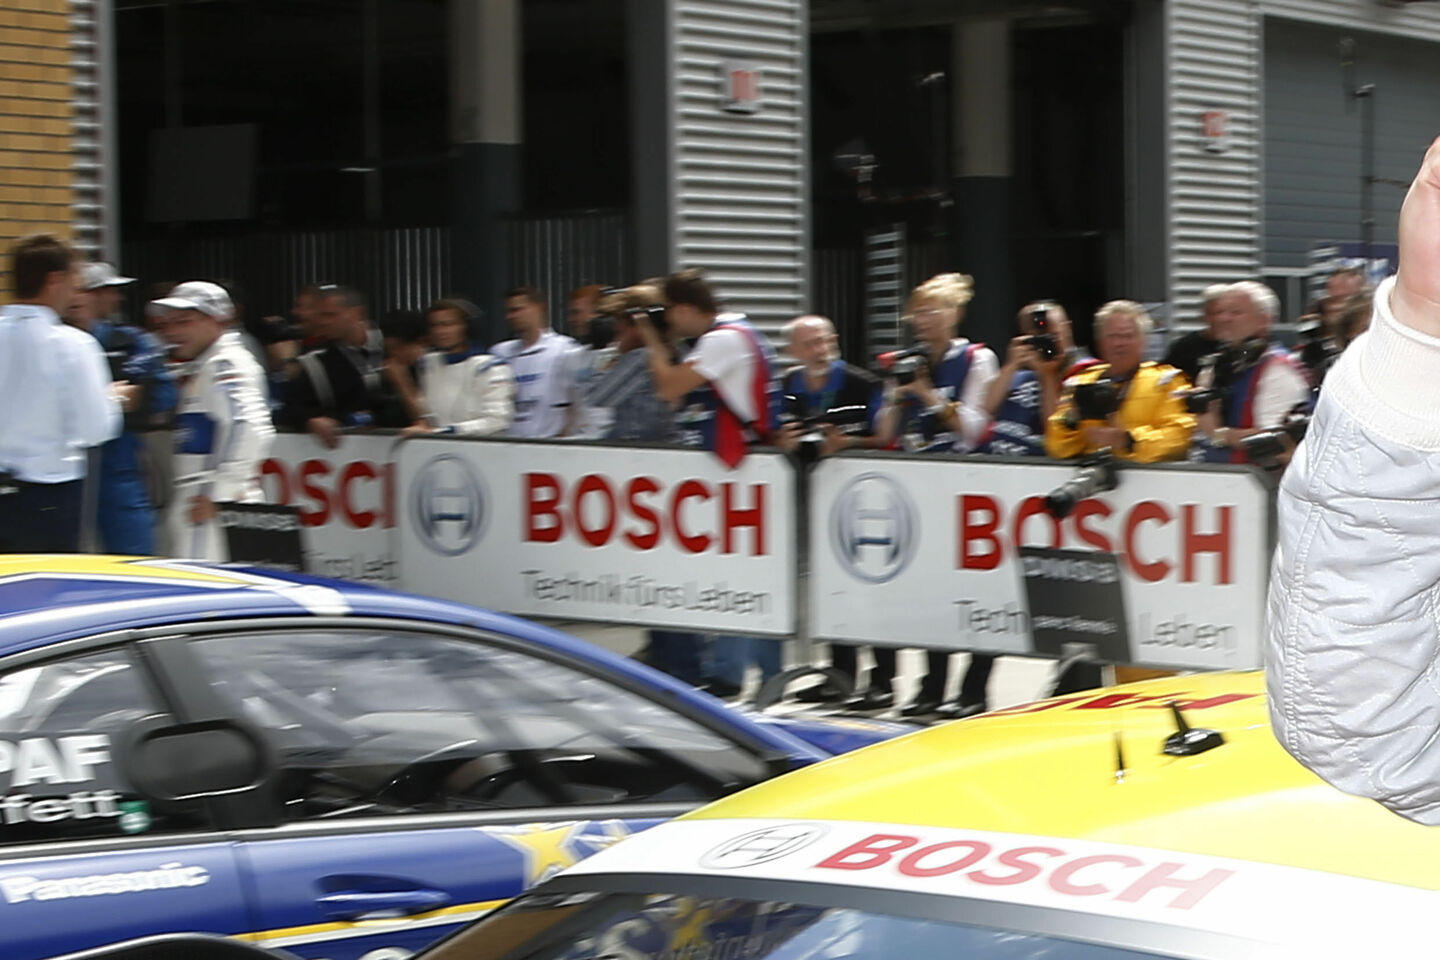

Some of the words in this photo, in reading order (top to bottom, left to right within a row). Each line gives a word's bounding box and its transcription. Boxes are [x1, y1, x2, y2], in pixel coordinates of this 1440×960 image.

[522, 473, 769, 556] BOSCH
[2, 862, 211, 903] Panasonic
[813, 834, 1235, 910] BOSCH
